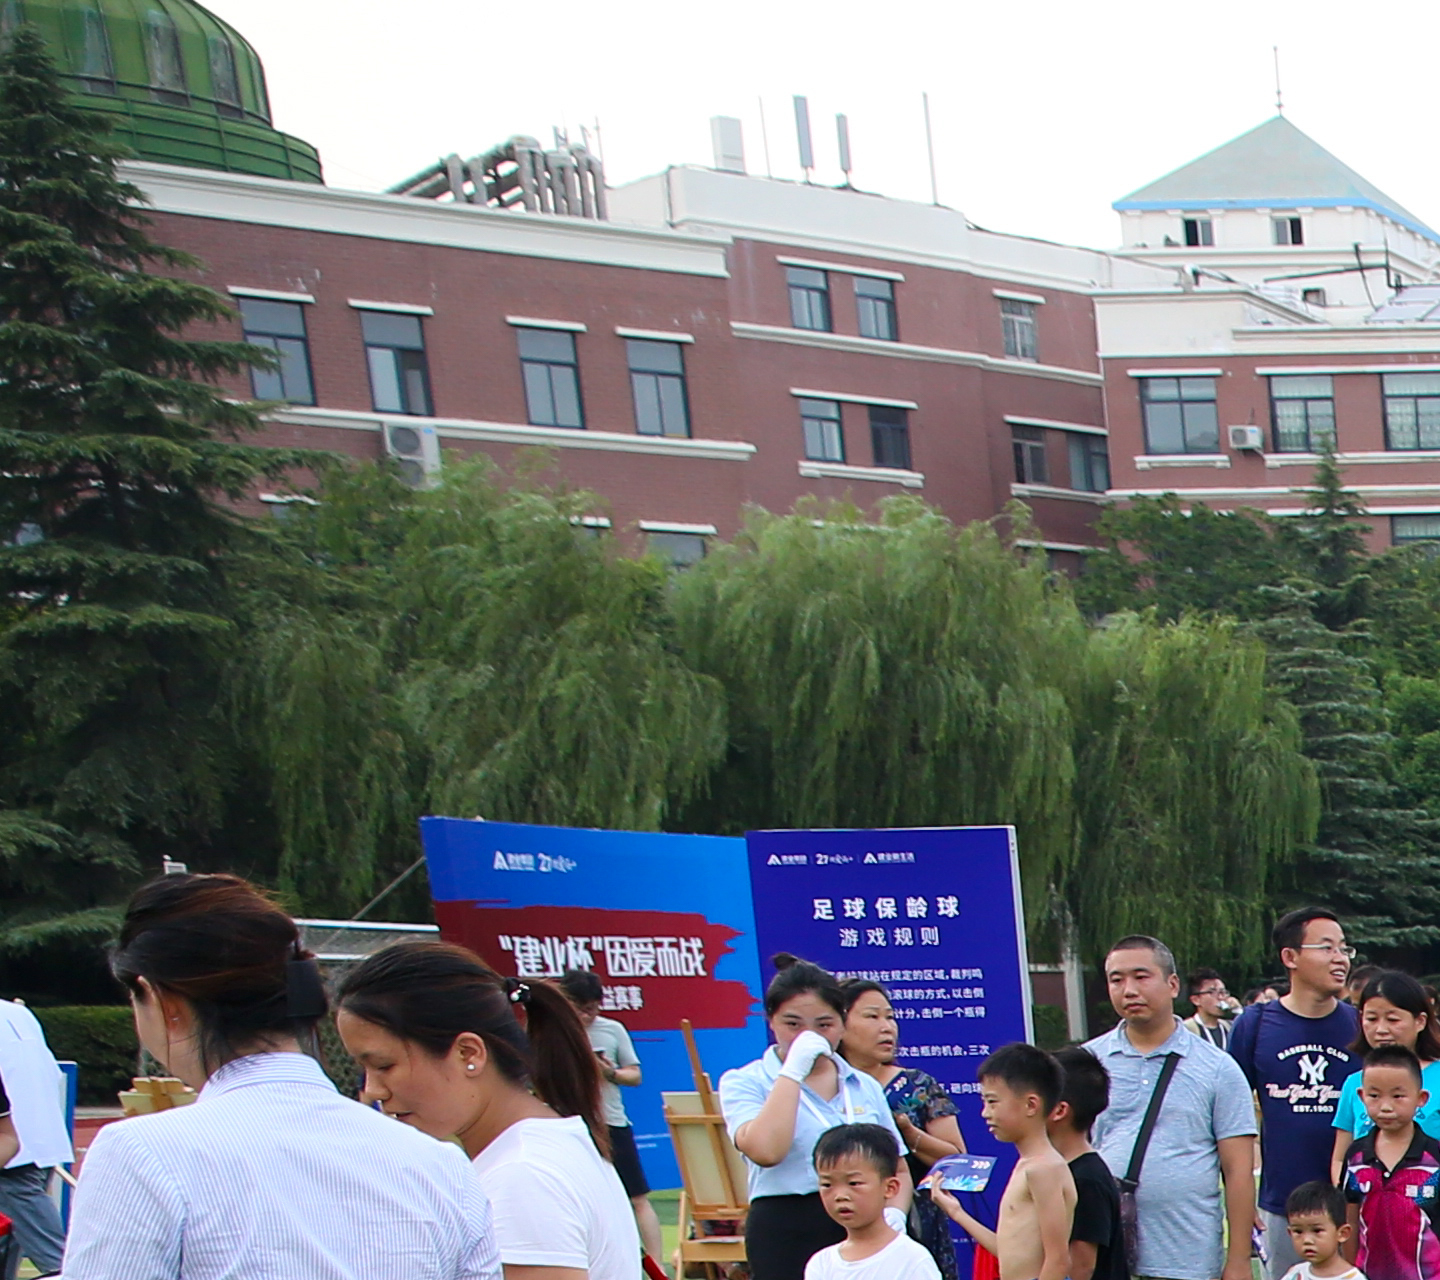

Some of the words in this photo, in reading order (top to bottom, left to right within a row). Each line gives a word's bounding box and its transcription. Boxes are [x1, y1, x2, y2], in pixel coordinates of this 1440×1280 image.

[813, 896, 960, 920] 足球保龄球
[839, 926, 940, 948] 游戏规则
[1277, 1044, 1324, 1060] BASEBALL
[1326, 1047, 1350, 1062] CLUB
